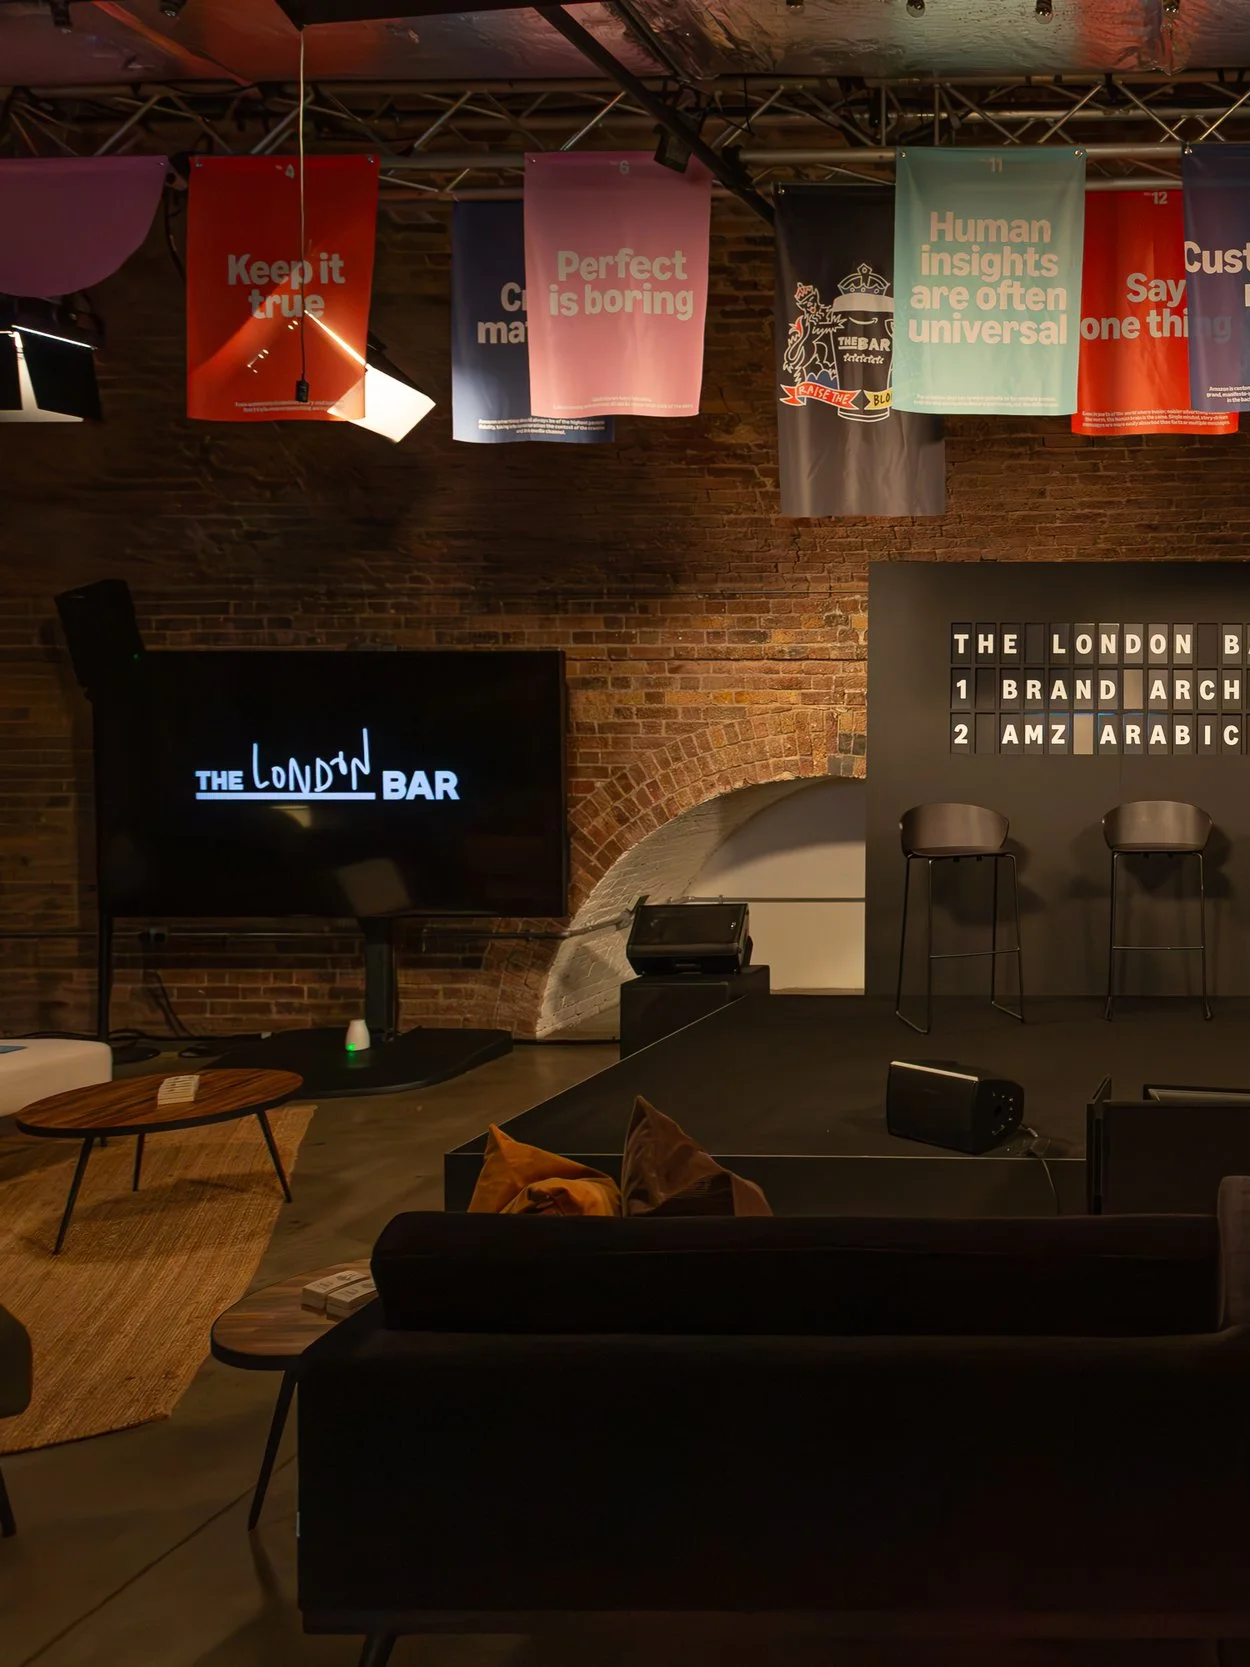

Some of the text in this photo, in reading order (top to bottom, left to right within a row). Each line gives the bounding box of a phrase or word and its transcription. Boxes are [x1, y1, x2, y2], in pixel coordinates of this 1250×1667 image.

[1152, 192, 1168, 205] 12
[930, 211, 1052, 243] Human
[228, 252, 345, 289] Keep it
[557, 248, 688, 281] Perfect
[921, 244, 1059, 283] insights
[248, 289, 324, 319] true
[549, 284, 579, 316] is
[584, 283, 694, 321] boring
[910, 279, 1067, 311] are often
[1126, 273, 1186, 308] Say
[908, 312, 1067, 345] universal
[1080, 316, 1141, 340] one
[838, 337, 890, 352] THE BAR
[799, 387, 851, 405] RAISE THE
[874, 393, 892, 406] BLO
[954, 634, 1018, 654] THE
[1053, 633, 1191, 655] LONDON
[956, 680, 967, 699] 1
[1003, 680, 1116, 700] BRAND
[1150, 680, 1240, 700] ARCH
[954, 724, 968, 744] 2
[1001, 724, 1066, 744] AMZ
[1100, 724, 1239, 745] ARABIC
[195, 771, 243, 790] THE
[382, 770, 460, 800] BAR
